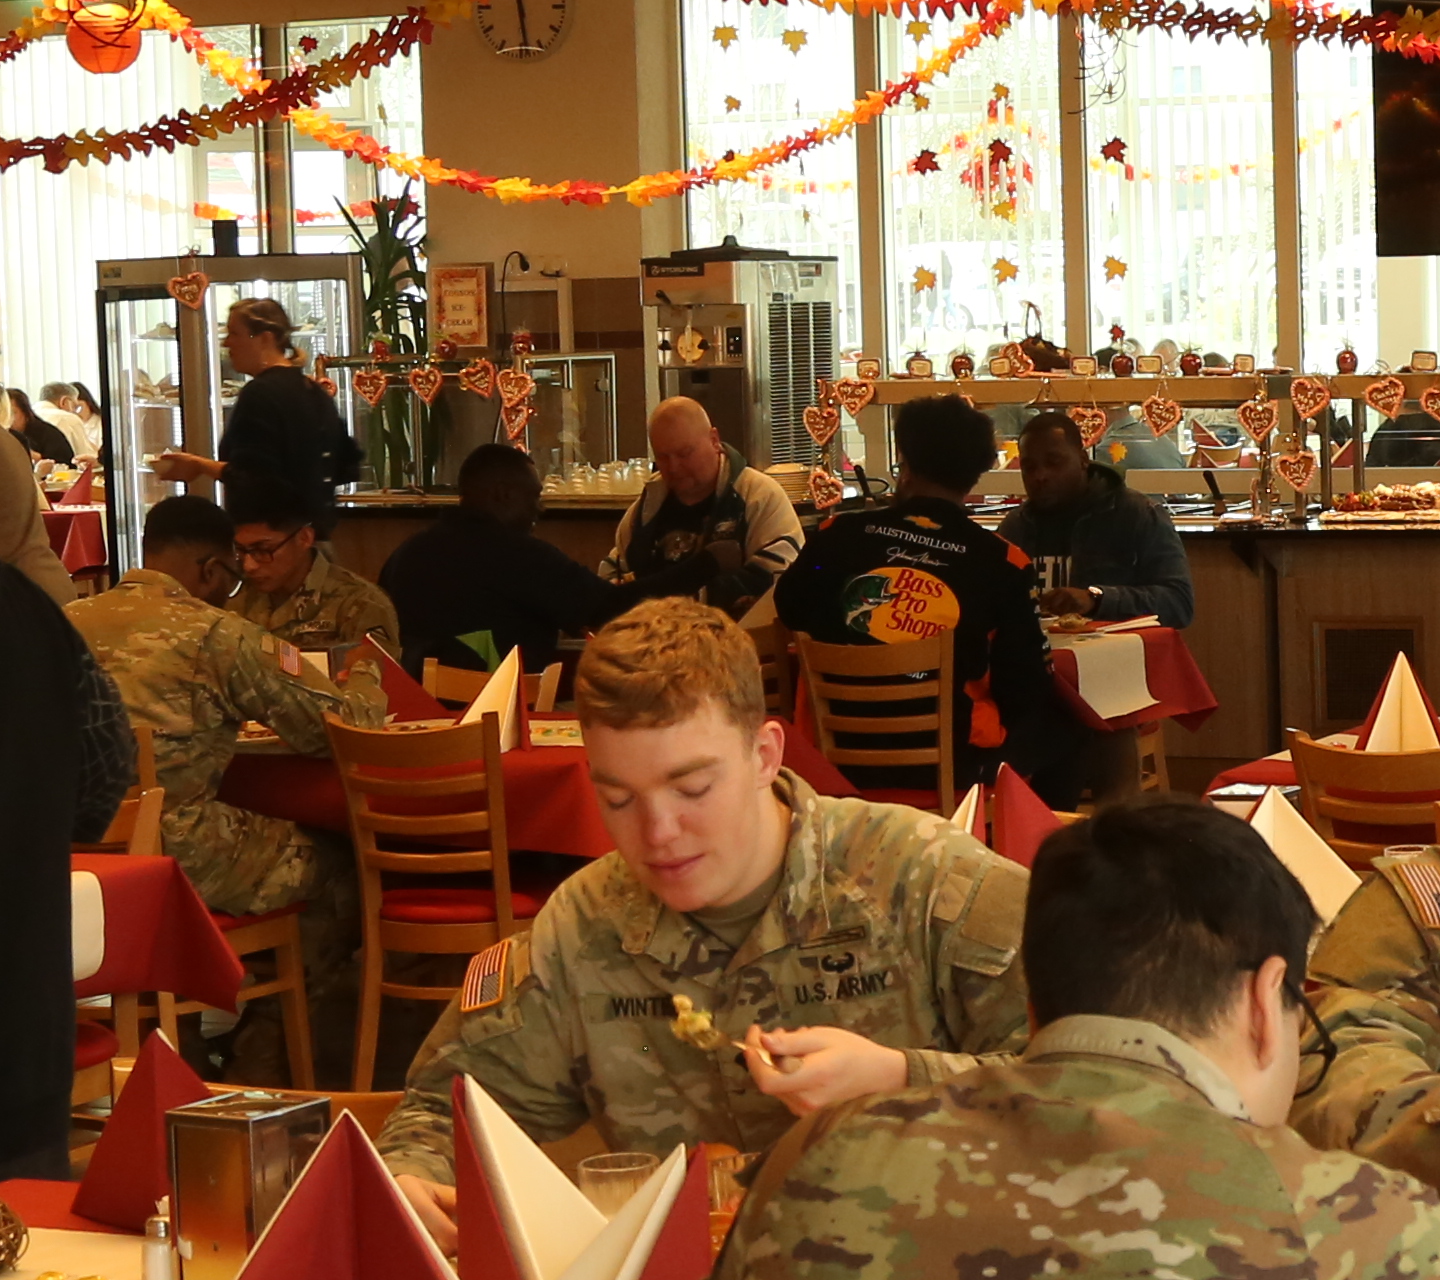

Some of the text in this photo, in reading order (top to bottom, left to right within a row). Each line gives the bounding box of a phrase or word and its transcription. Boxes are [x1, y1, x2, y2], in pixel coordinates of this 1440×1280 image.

[893, 569, 945, 599] Bass
[890, 590, 928, 614] Pro
[794, 969, 890, 1004] U.S. ARMY
